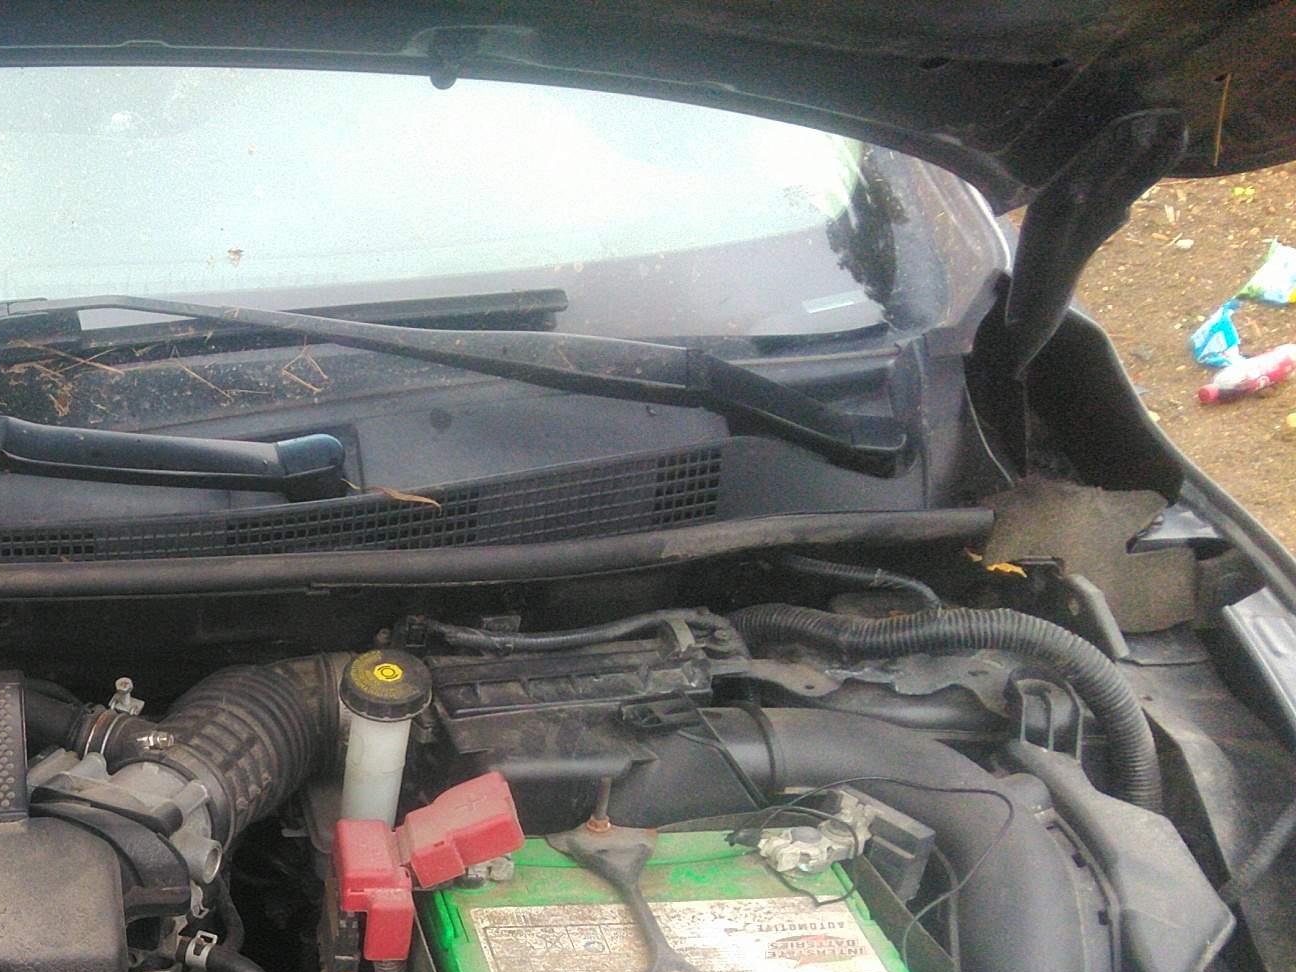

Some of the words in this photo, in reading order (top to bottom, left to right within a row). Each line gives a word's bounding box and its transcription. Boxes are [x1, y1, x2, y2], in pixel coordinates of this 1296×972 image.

[758, 921, 844, 933] AUTOMOTIVE
[768, 939, 858, 950] BATTERIES
[766, 948, 865, 959] INTERSTATE
